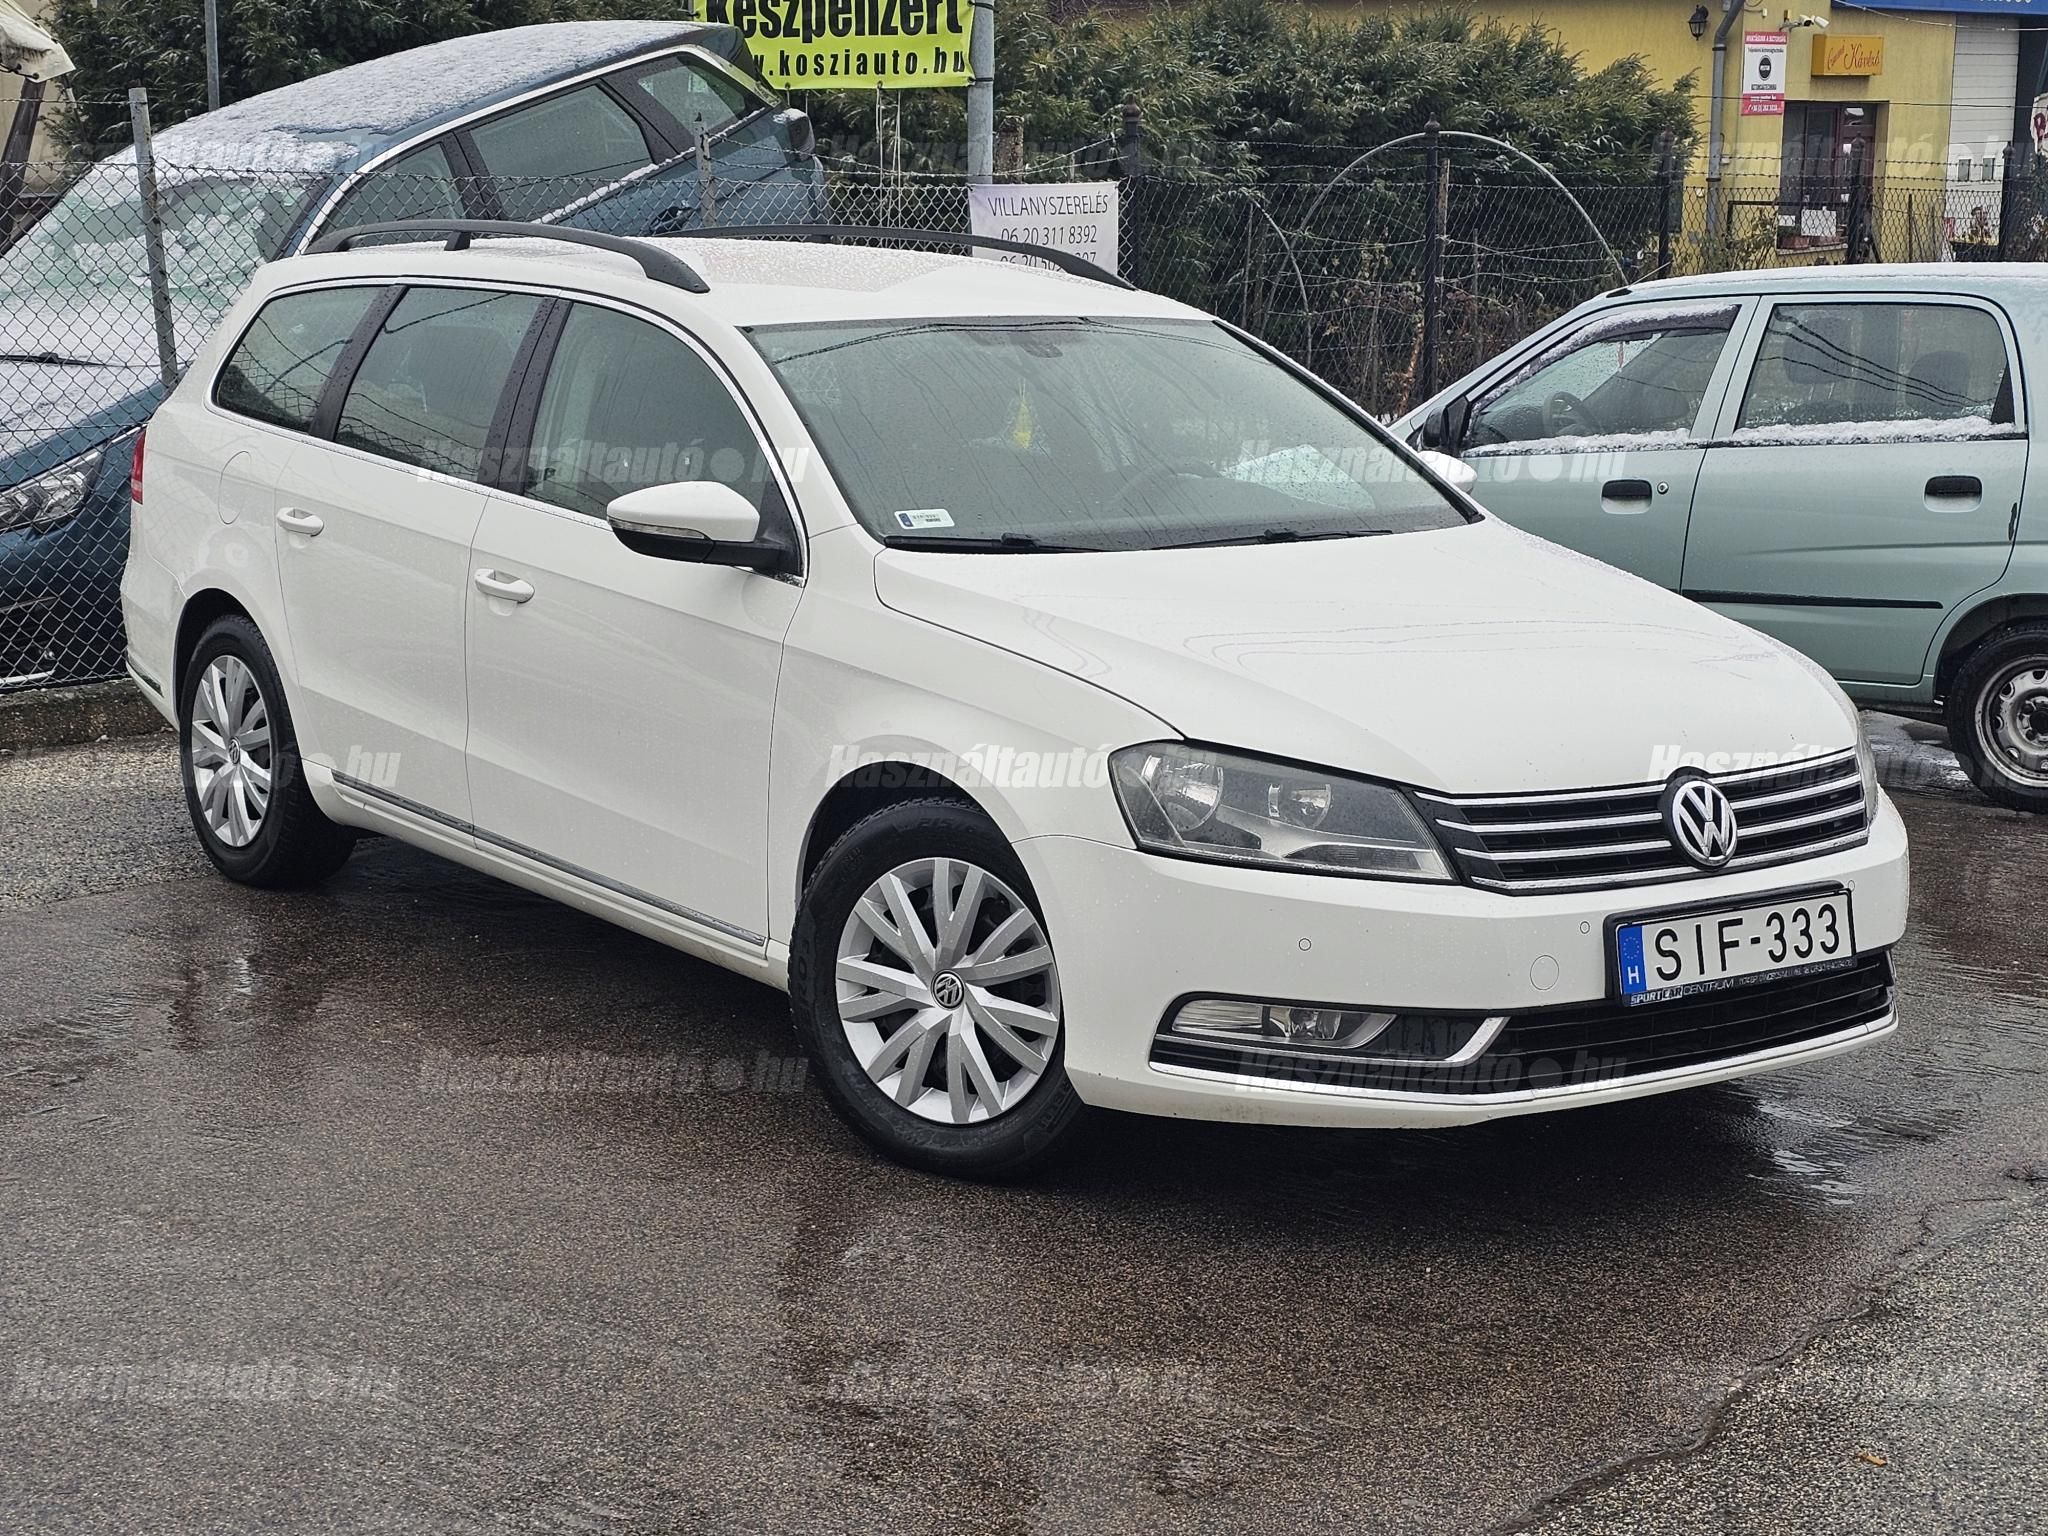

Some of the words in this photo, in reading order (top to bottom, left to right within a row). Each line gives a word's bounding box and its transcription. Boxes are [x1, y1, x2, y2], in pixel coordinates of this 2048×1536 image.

[987, 191, 1109, 217] VILLANYSZERELÉS
[1042, 227, 1065, 245] 311
[1068, 225, 1097, 244] 8392
[1655, 904, 1840, 981] SIF-333
[1627, 965, 1640, 985] H
